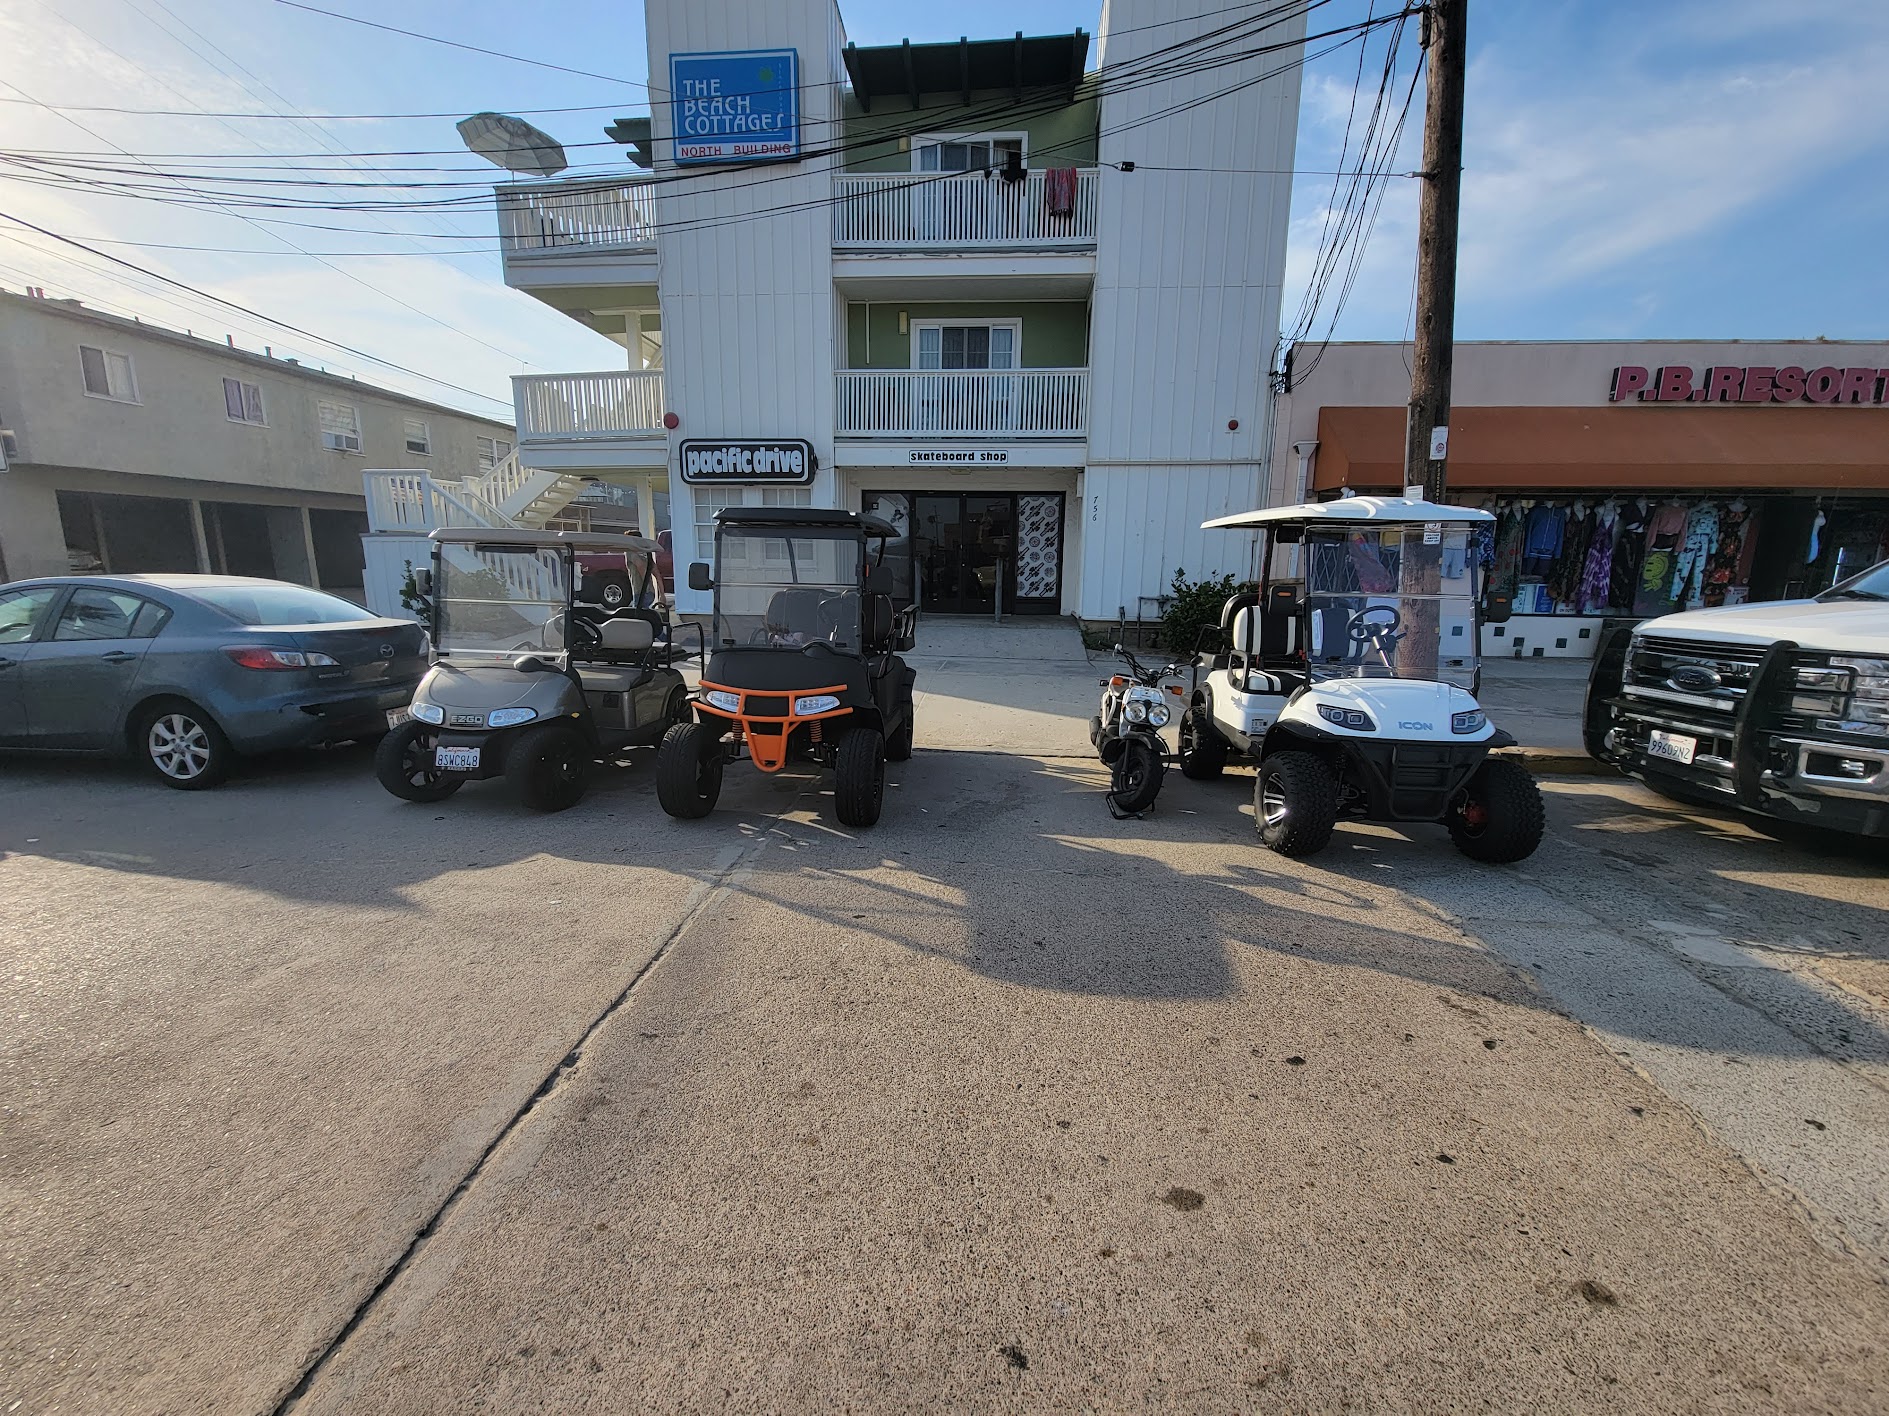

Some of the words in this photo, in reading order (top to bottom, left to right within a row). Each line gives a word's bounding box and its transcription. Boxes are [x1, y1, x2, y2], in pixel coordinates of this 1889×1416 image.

[683, 79, 721, 96] THE
[684, 96, 750, 116] BEACH
[685, 113, 785, 134] COTTAGES
[681, 146, 722, 157] NORTH
[733, 144, 791, 155] BUILDING
[687, 447, 752, 476] pacific
[753, 447, 803, 474] drive
[911, 452, 975, 461] skateboard
[980, 452, 1007, 461] shop
[1398, 721, 1433, 731] ICON
[1651, 740, 1690, 760] 99609N2
[438, 754, 478, 767] 8SWC848
